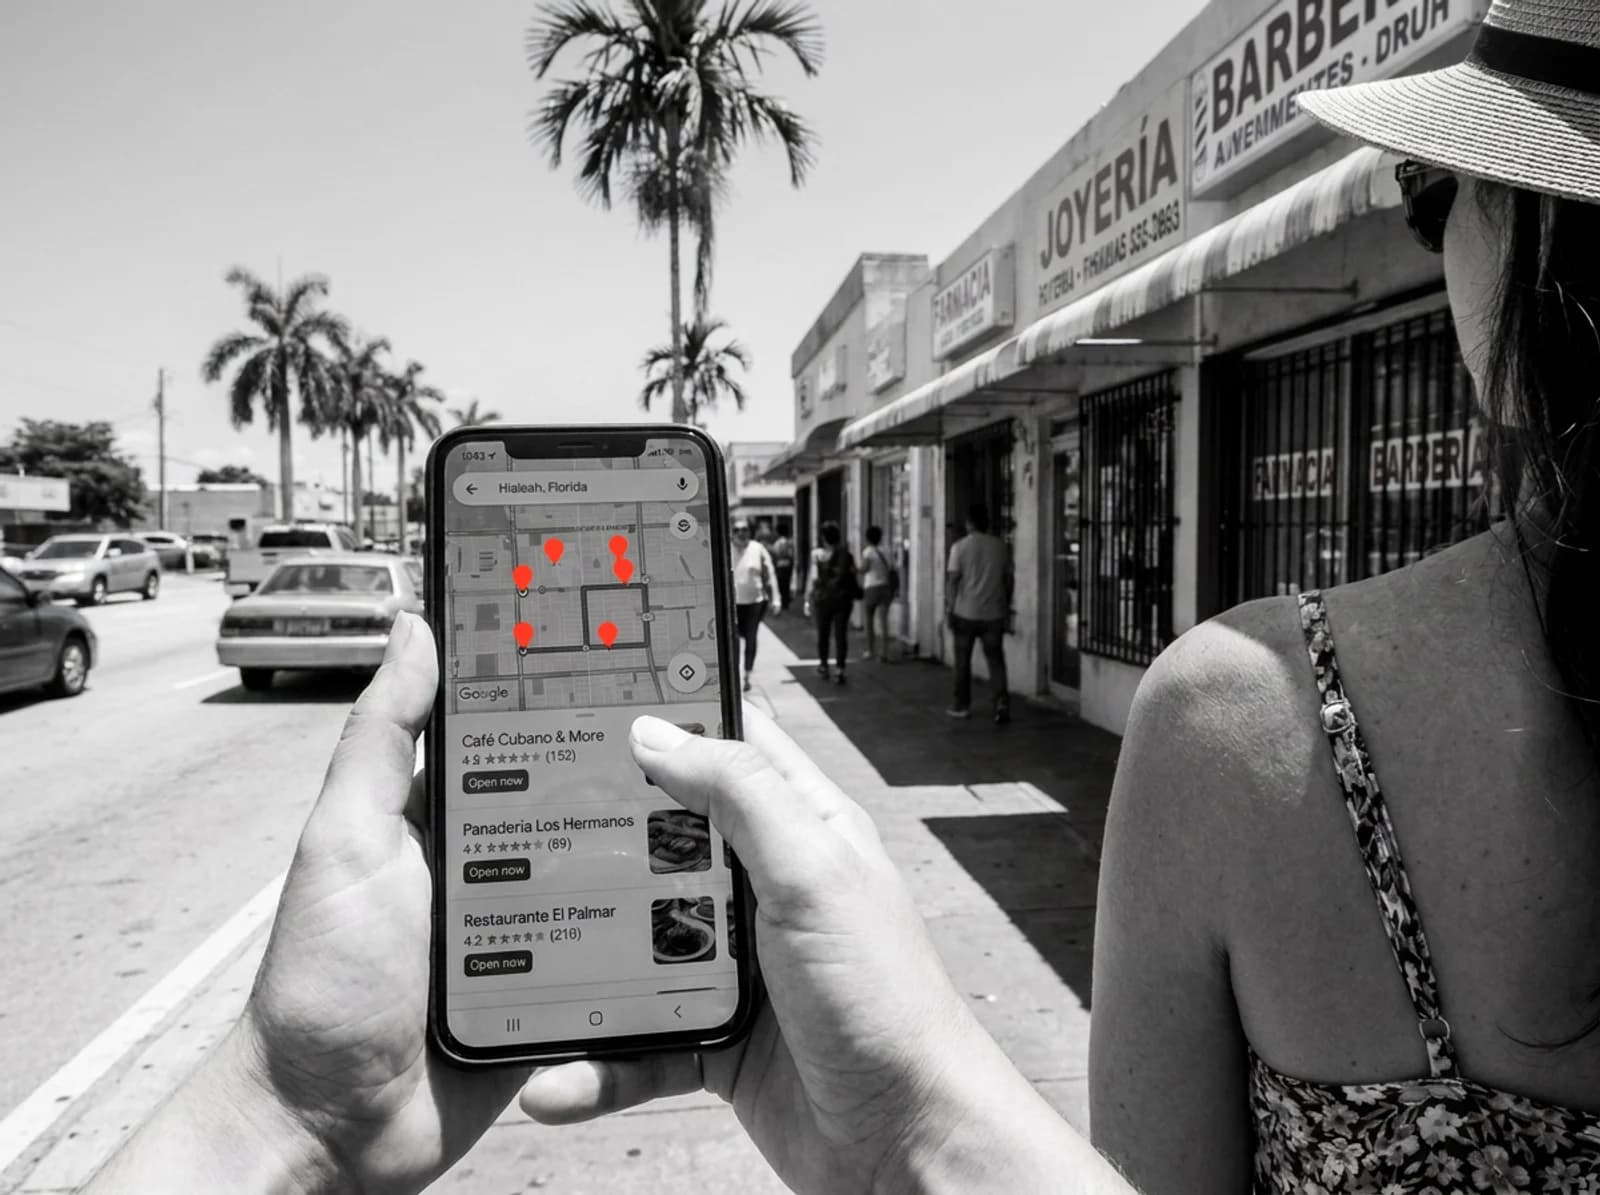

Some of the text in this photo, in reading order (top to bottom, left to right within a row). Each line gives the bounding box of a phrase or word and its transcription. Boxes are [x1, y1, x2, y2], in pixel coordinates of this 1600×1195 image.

[1040, 115, 1178, 270] JOYERÍA
[1372, 433, 1486, 488] BARBERA
[498, 481, 588, 494] Hialeah, Florida
[459, 686, 508, 701] Google
[462, 730, 605, 747] Café Cubano & More
[545, 749, 576, 764] (152)
[468, 776, 523, 789] Open now
[536, 819, 560, 832] Los
[563, 815, 634, 831] Hermanos
[469, 865, 525, 879] Open now
[463, 905, 616, 927] Restaurante El Palmar
[470, 958, 526, 972] Open now
